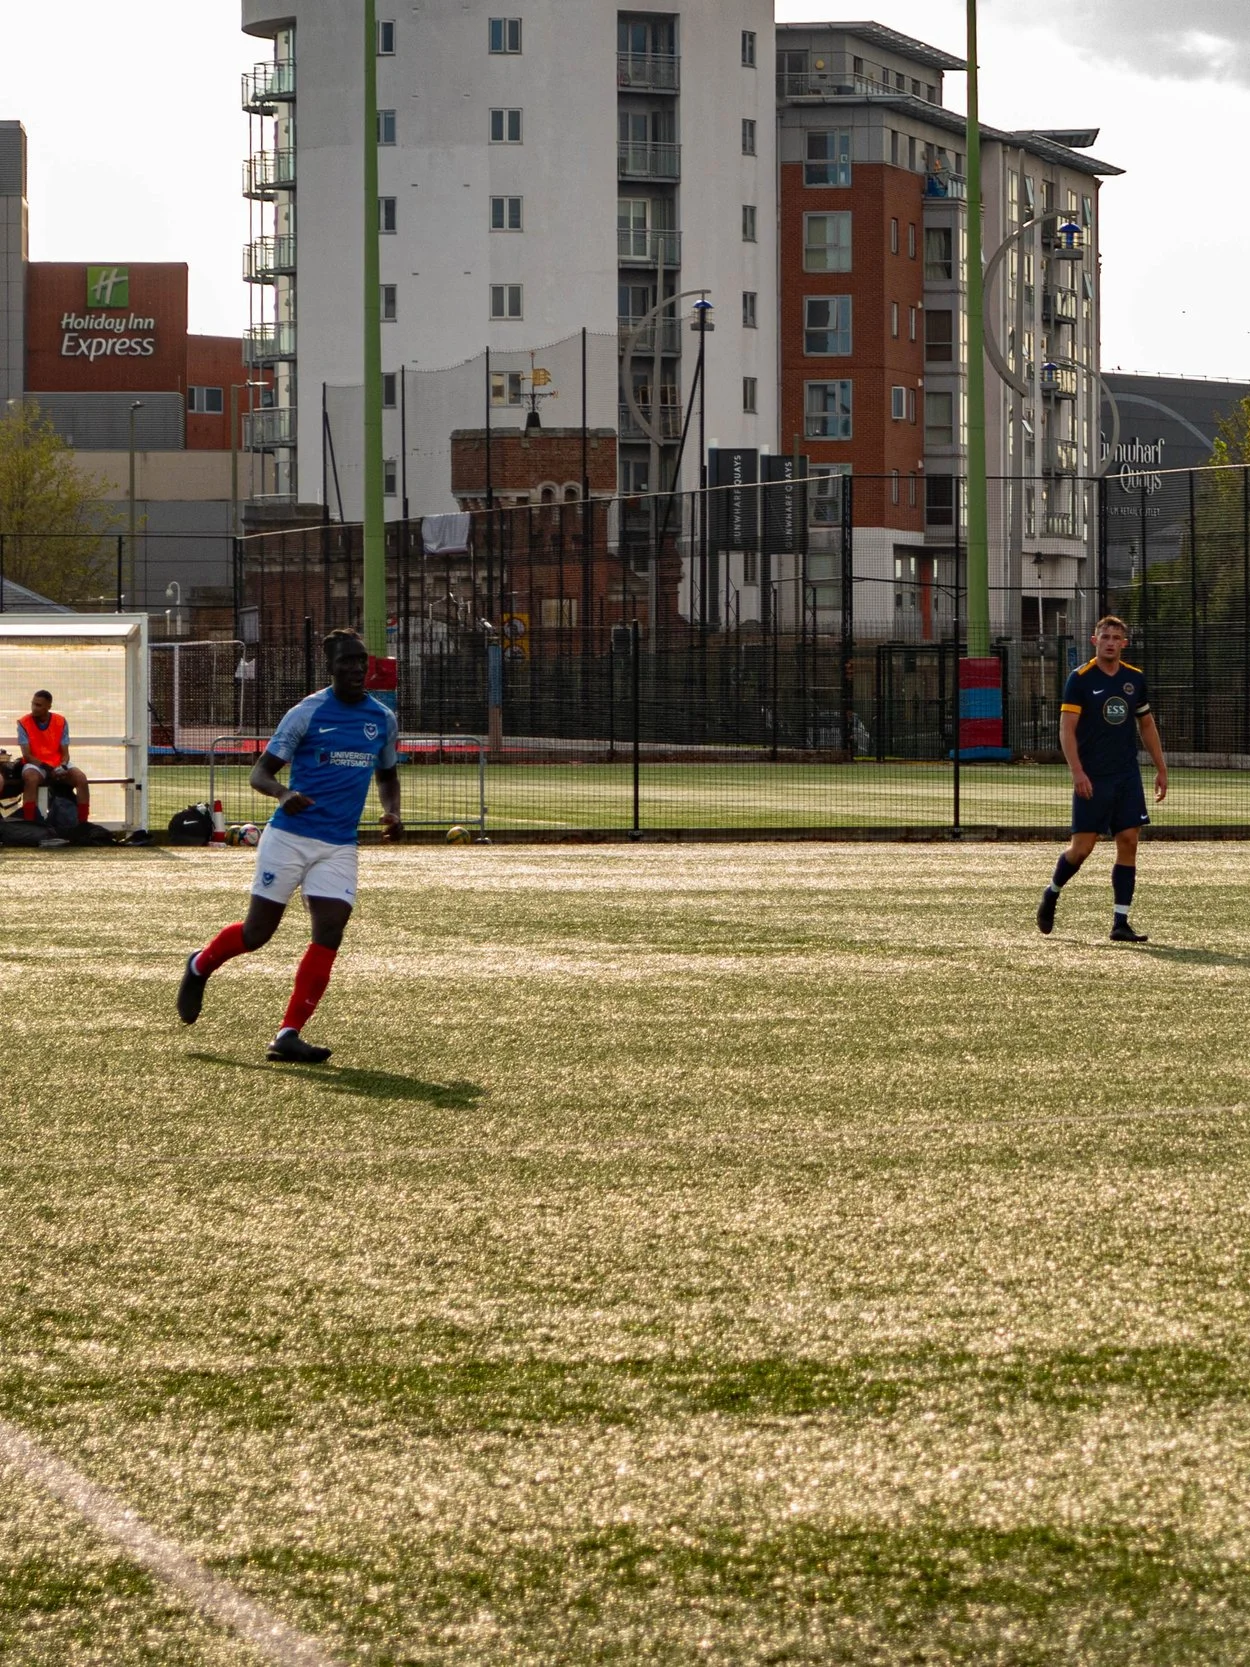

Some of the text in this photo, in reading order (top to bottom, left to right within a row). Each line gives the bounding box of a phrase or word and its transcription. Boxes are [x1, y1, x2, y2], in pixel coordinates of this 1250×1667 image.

[61, 312, 155, 333] Holiday Inn
[61, 333, 154, 362] Express
[785, 461, 793, 493] QAYS
[1120, 463, 1161, 495] Quays
[734, 455, 742, 544] UNWHARF QUAYS
[1106, 705, 1125, 714] ESS
[329, 758, 373, 768] PORTSMO
[330, 751, 374, 760] UNIVERSITY
